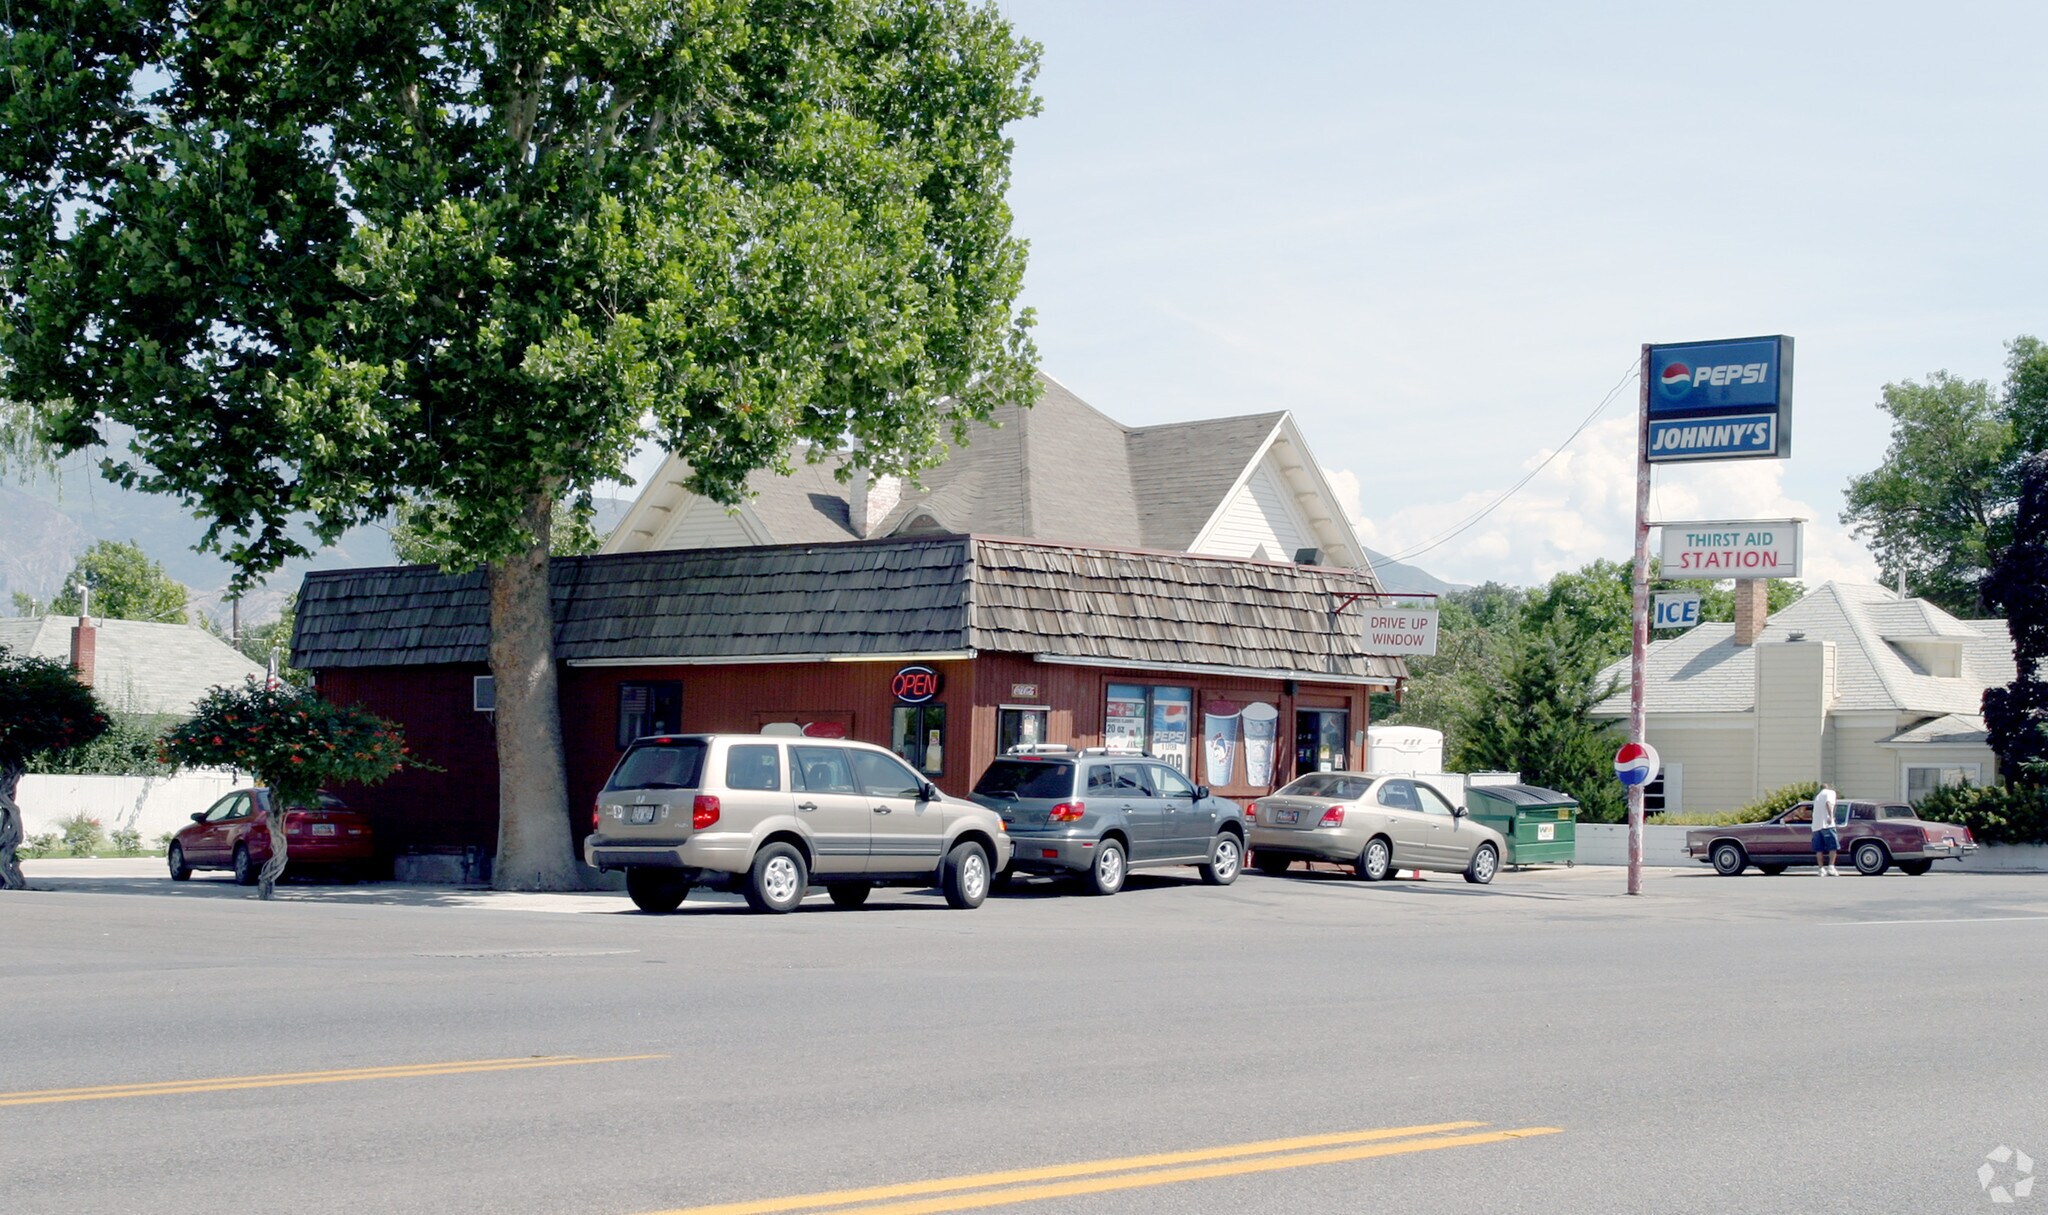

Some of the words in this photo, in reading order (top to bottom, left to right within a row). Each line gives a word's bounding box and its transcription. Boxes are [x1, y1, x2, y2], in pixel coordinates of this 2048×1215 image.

[1693, 363, 1768, 387] PEPSI
[1653, 423, 1767, 450] JOHNNY'S
[1686, 533, 1741, 548] THIRST
[1745, 532, 1773, 546] AID
[1680, 551, 1778, 569] STATION
[1657, 600, 1698, 623] ICE
[1371, 616, 1406, 629] DRIVE
[1411, 618, 1428, 630] UP
[1372, 634, 1425, 646] WINDOW
[892, 674, 937, 695] OPEN
[1107, 724, 1116, 733] 20
[1153, 731, 1186, 742] PEPSI
